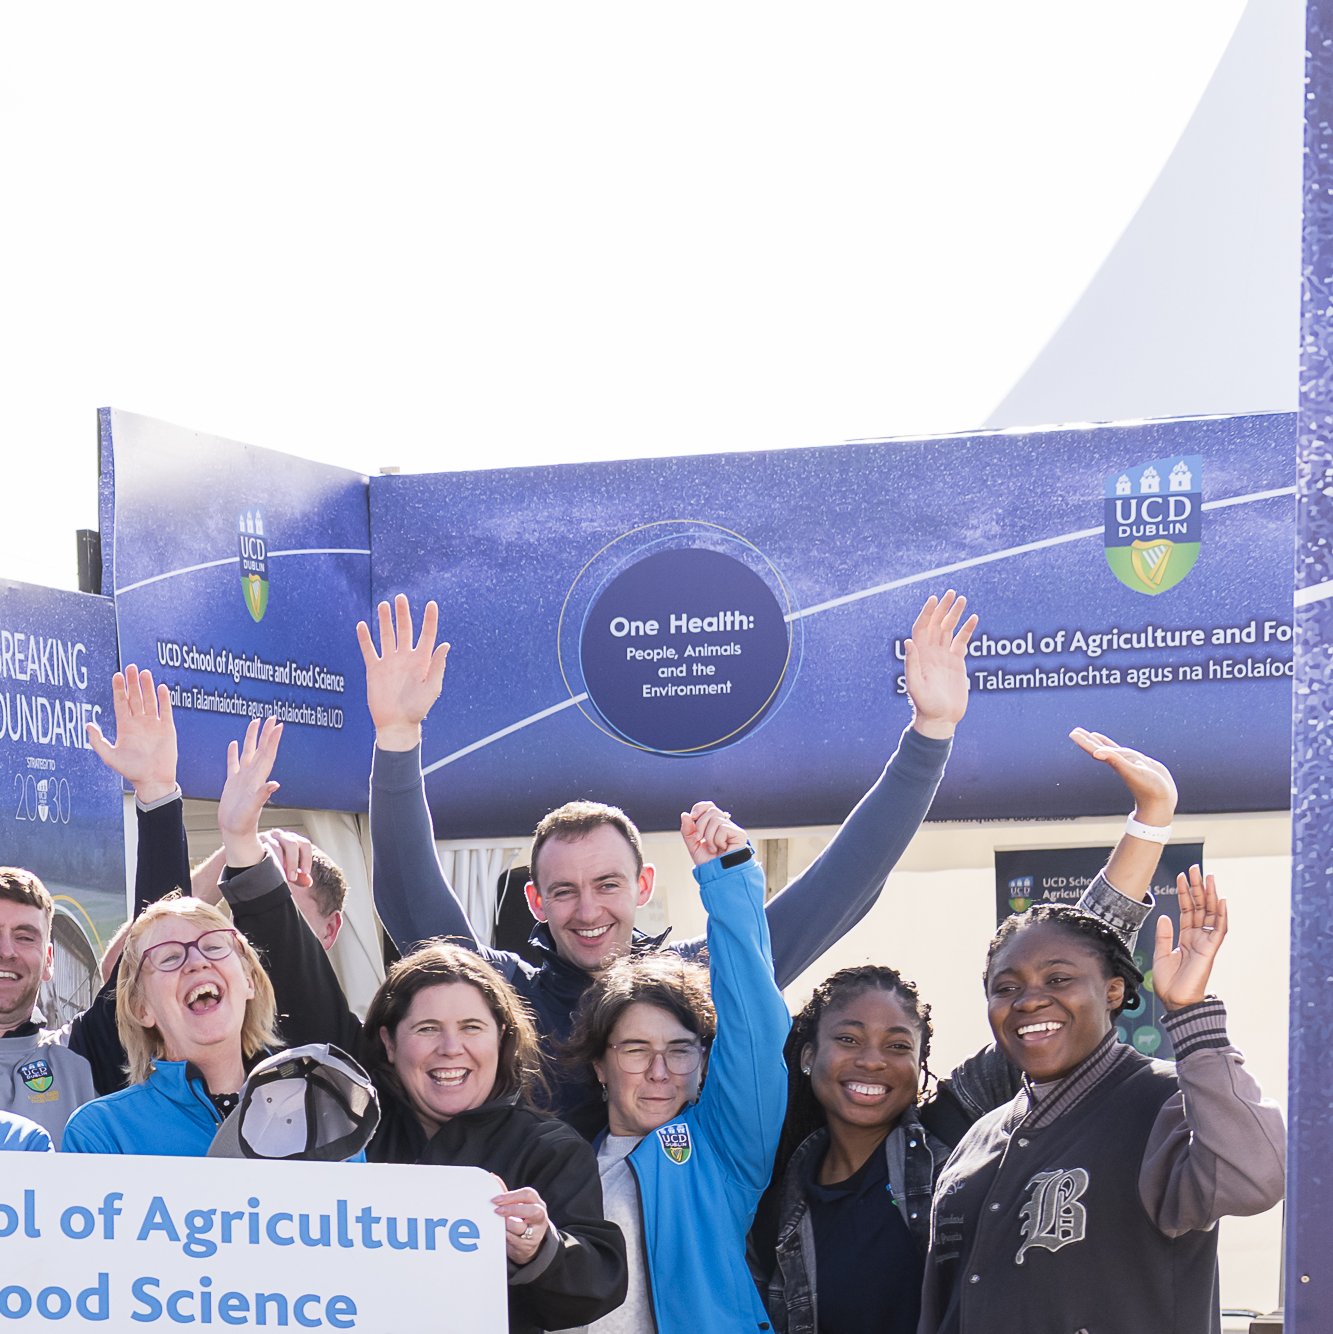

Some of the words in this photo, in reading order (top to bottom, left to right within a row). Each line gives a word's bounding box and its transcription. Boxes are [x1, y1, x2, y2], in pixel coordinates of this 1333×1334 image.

[1114, 496, 1192, 526] UCD
[1118, 521, 1188, 539] DUBLIN
[240, 536, 265, 560] UCD
[243, 559, 265, 572] DUBLIN
[610, 615, 659, 638] One
[670, 610, 755, 634] Health:
[963, 632, 1034, 658] chool
[1040, 630, 1065, 653] of
[1070, 625, 1205, 657] Agriculture
[1212, 621, 1256, 644] and
[1264, 621, 1293, 642] Fo
[626, 644, 678, 664] People,
[684, 641, 742, 658] Animals
[158, 641, 181, 667] UCD
[183, 643, 214, 672] School
[216, 650, 226, 674] of
[228, 652, 273, 683] Agriculture
[275, 661, 290, 684] and
[292, 663, 313, 687] Food
[315, 667, 344, 692] Science
[658, 662, 687, 678] and
[691, 661, 716, 676] the
[975, 665, 1121, 690] Talamhaíochta
[1127, 661, 1173, 687] agus
[1179, 661, 1202, 681] na
[642, 680, 732, 698] Environment
[183, 691, 191, 708] na
[248, 701, 264, 721] agus
[317, 707, 328, 727] Bia
[329, 709, 343, 729] UCD
[1042, 877, 1066, 888] UCD
[1069, 876, 1093, 887] Scho
[1042, 889, 1085, 901] Agricult
[23, 1066, 47, 1077] UCD
[662, 1134, 687, 1143] UCD
[60, 1192, 124, 1241] of
[136, 1196, 480, 1259] Agriculture
[131, 1276, 358, 1329] Science
